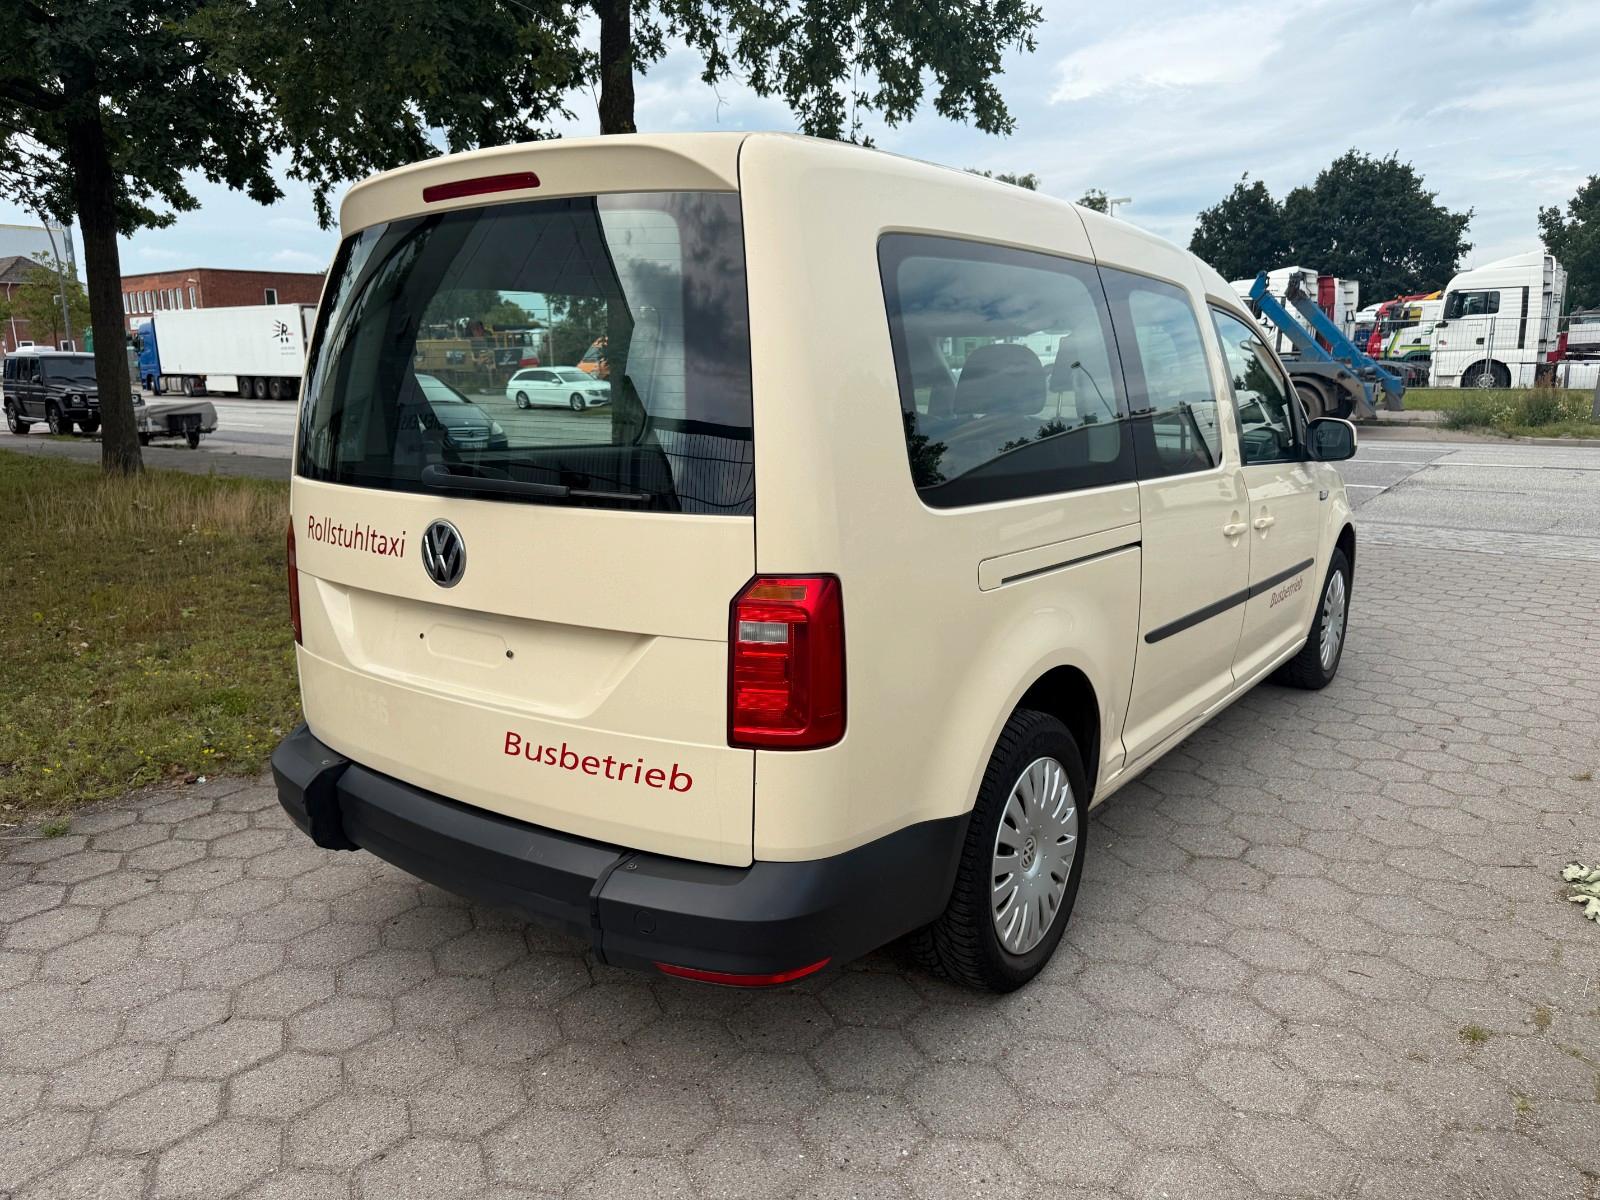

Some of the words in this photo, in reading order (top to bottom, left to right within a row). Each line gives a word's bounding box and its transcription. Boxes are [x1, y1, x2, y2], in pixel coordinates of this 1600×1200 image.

[307, 515, 406, 557] Rollstuhltaxi
[423, 519, 466, 588] VW
[1269, 575, 1304, 609] Busbetrieb
[504, 731, 694, 793] Busbetrieb
